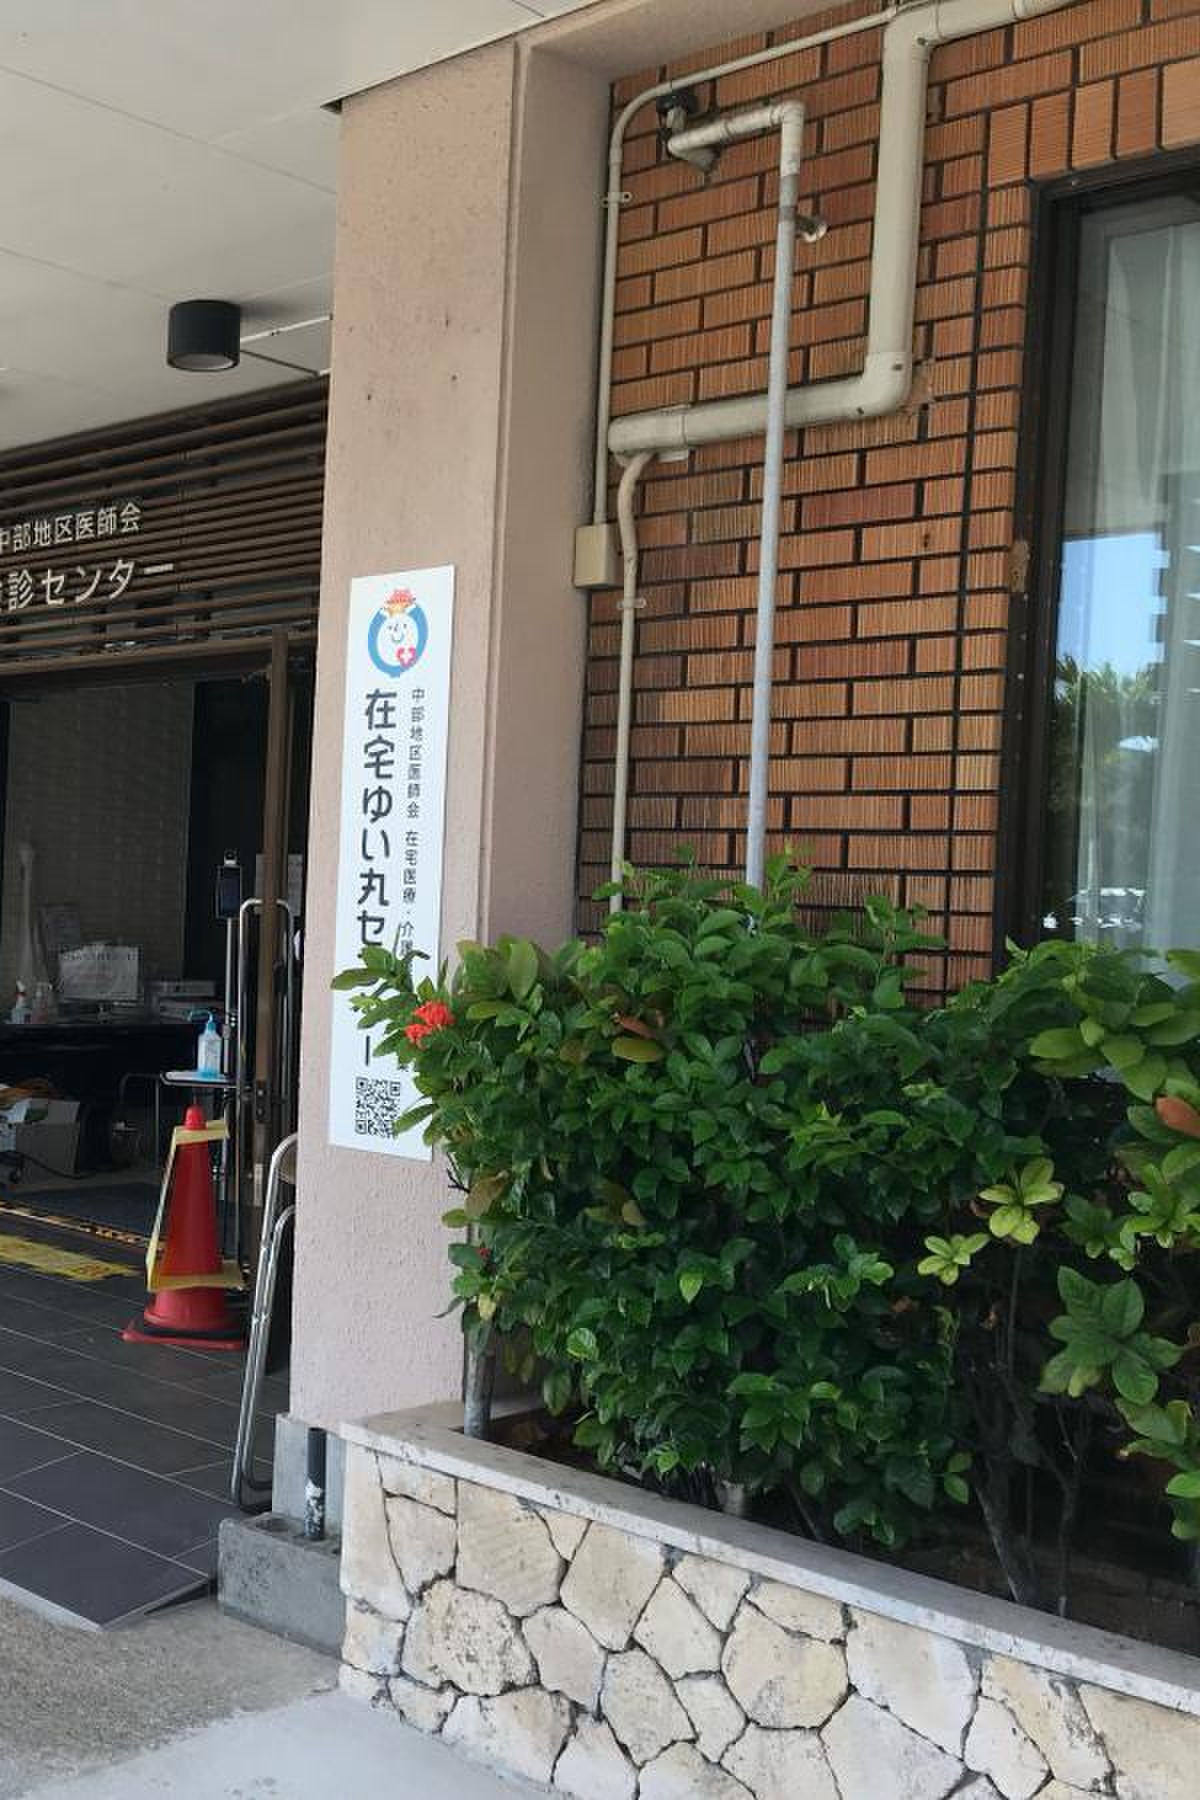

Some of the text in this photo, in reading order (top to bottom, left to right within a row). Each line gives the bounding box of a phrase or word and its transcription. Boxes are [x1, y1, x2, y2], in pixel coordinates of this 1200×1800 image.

[353, 689, 398, 1066] 在宅ゆい丸セー
[406, 688, 425, 818] 中部地区医師会
